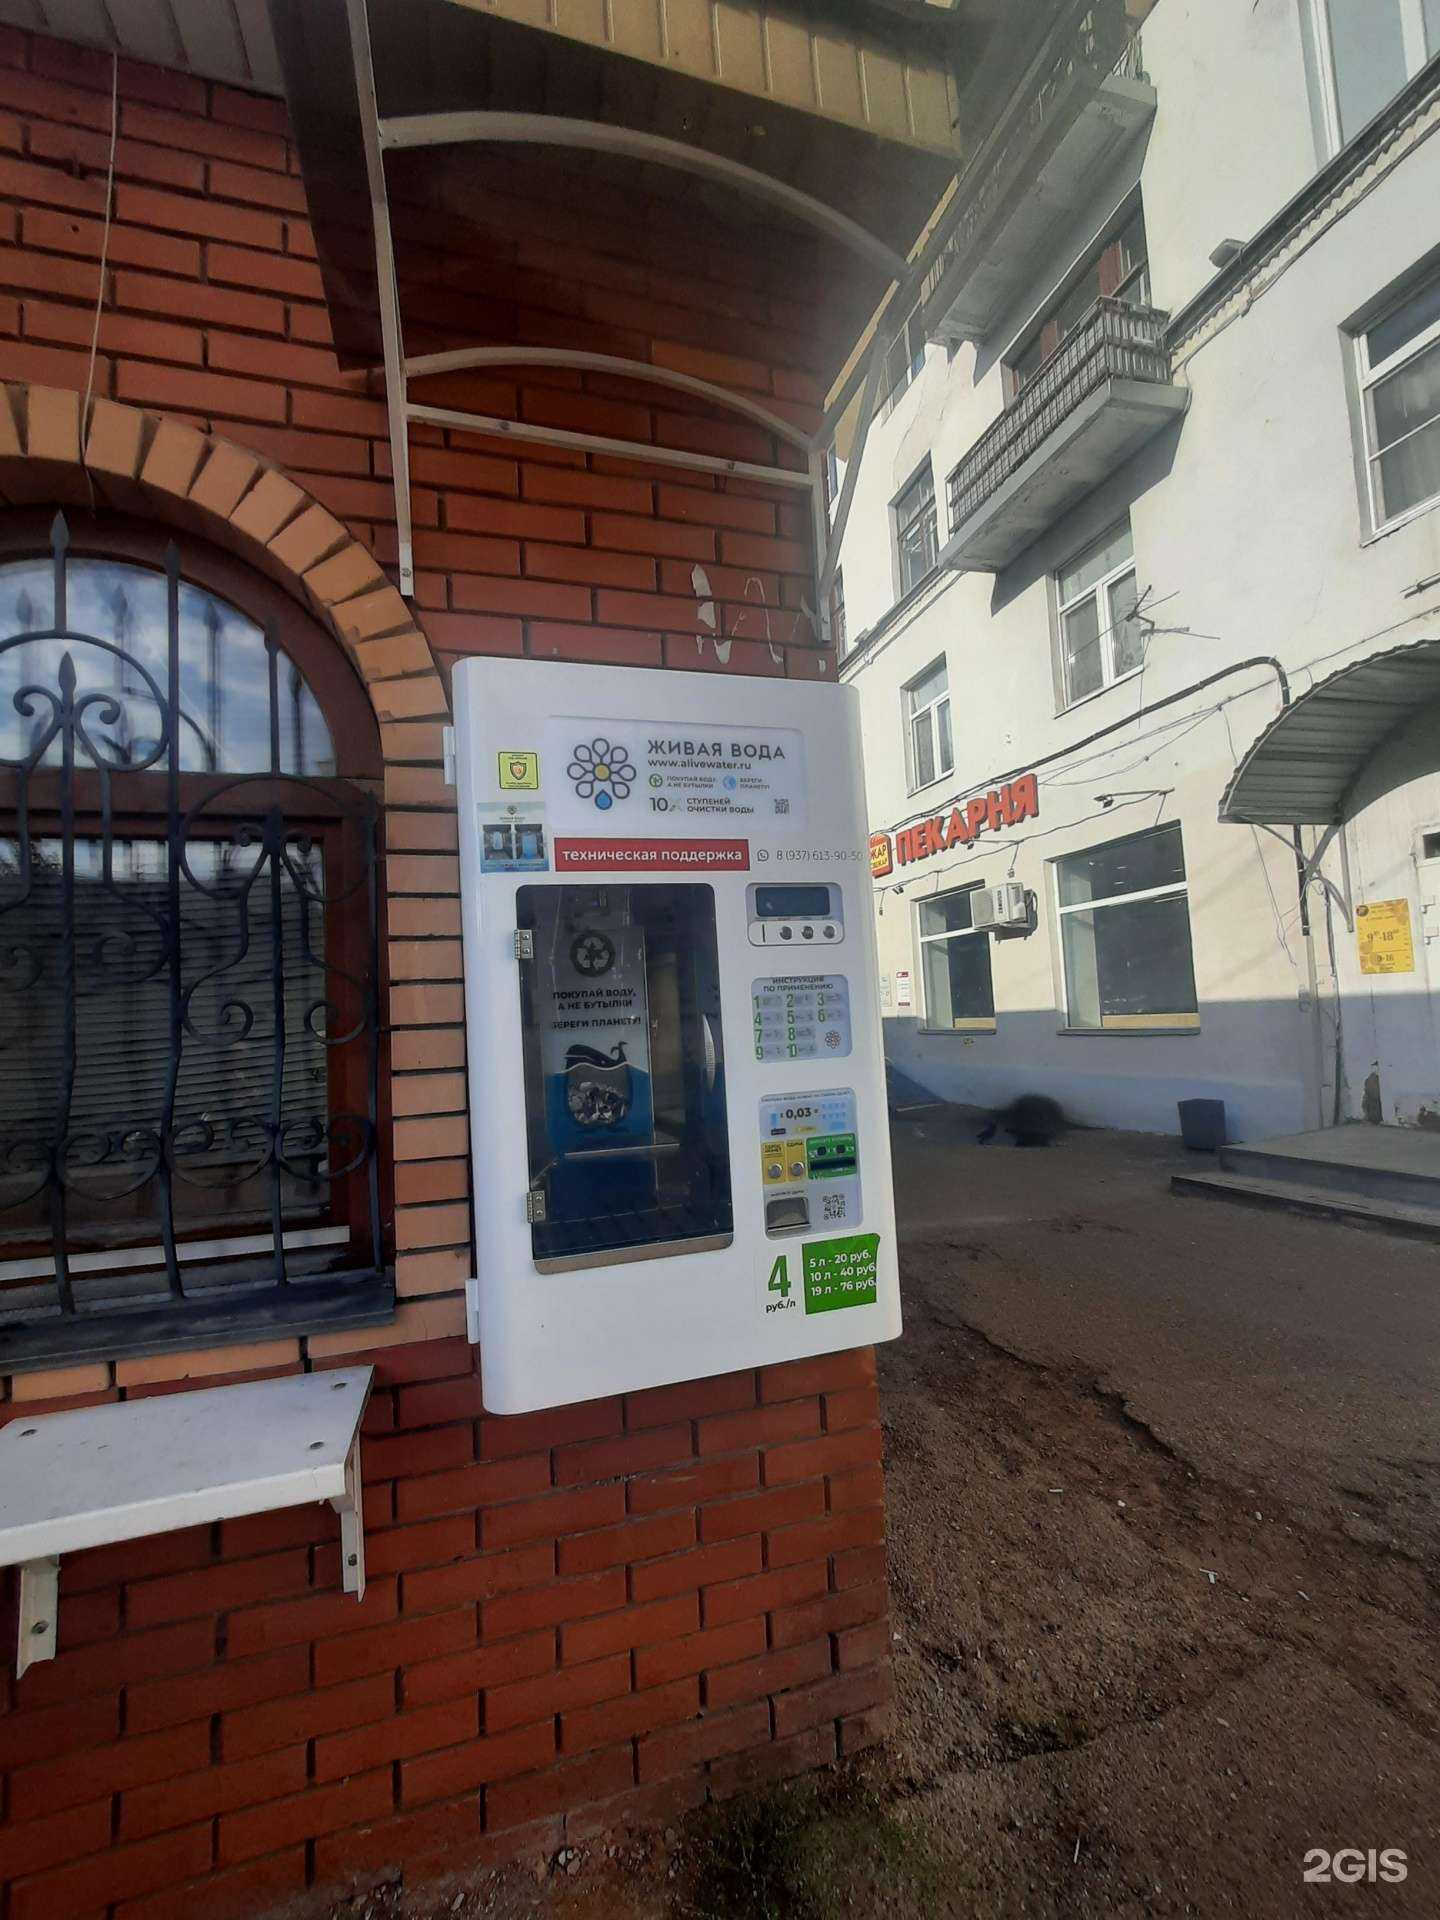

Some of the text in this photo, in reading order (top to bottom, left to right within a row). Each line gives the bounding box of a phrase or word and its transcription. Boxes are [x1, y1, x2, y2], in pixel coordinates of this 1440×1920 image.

[648, 740, 785, 760] ЖИВАЯ ВОДА
[648, 759, 751, 769] www.alivewater.ru
[649, 797, 668, 812] 10
[686, 797, 731, 805] СТУПЕНЕЙ
[687, 805, 727, 813] ОЧИСТКИ
[896, 773, 1039, 866] ПЕКАРНЯ
[562, 849, 742, 865] техническая поддержка
[776, 849, 783, 861] 8
[785, 849, 810, 861] (937)
[552, 988, 604, 999] ПОКУПАЙ
[785, 1107, 812, 1120] 0,03
[809, 1259, 816, 1268] 5
[818, 1258, 826, 1267] л
[834, 1254, 848, 1264] 20
[850, 1249, 872, 1264] руб.
[768, 1255, 791, 1297] 4
[810, 1272, 822, 1282] 10
[824, 1271, 831, 1280] л
[840, 1266, 854, 1276] 40
[811, 1286, 822, 1297] 19
[824, 1286, 832, 1294] л
[840, 1281, 853, 1291] 76
[765, 1298, 796, 1314] руб./л
